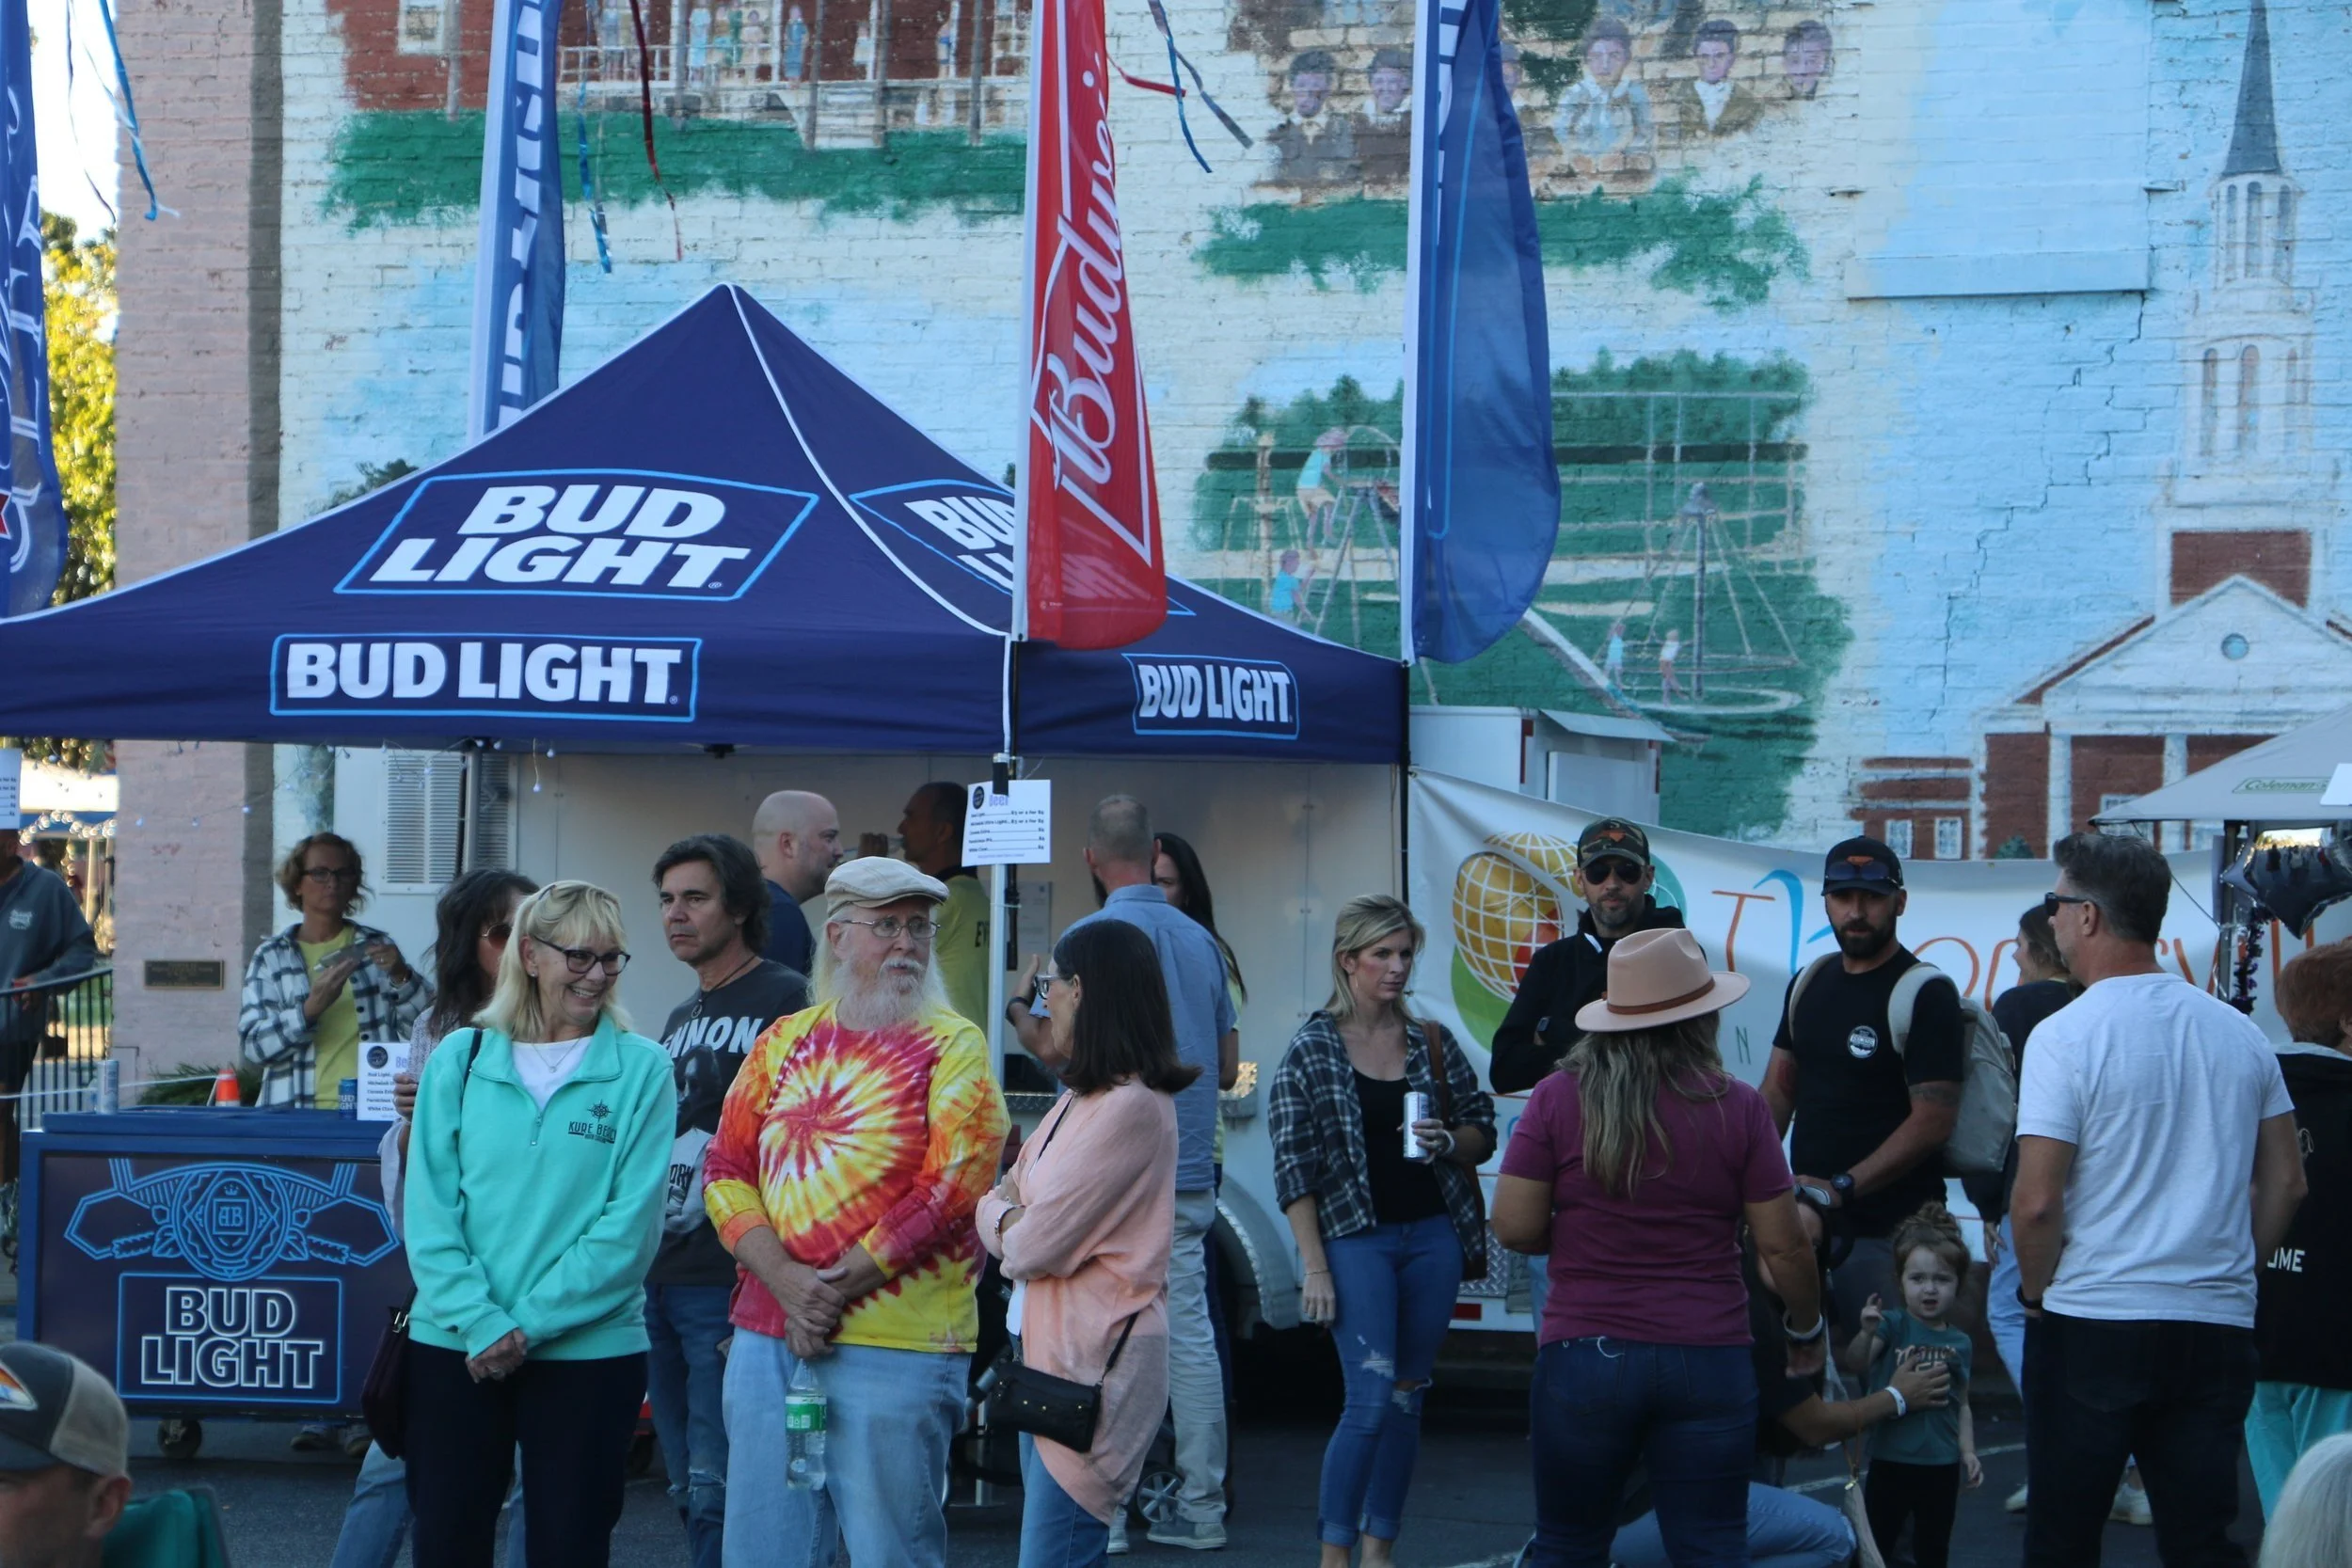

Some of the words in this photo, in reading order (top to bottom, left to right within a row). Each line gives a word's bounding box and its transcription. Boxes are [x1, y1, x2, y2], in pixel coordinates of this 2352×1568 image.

[457, 484, 725, 538] BUD
[369, 535, 751, 588] LIGHT
[287, 641, 446, 699] BUD
[458, 641, 682, 704] LIGHT
[1137, 664, 1203, 719] BUD
[1204, 664, 1291, 723] LIGHT
[568, 1121, 594, 1134] KURE
[166, 1286, 296, 1338] BUD
[140, 1335, 325, 1390] LIGHT
